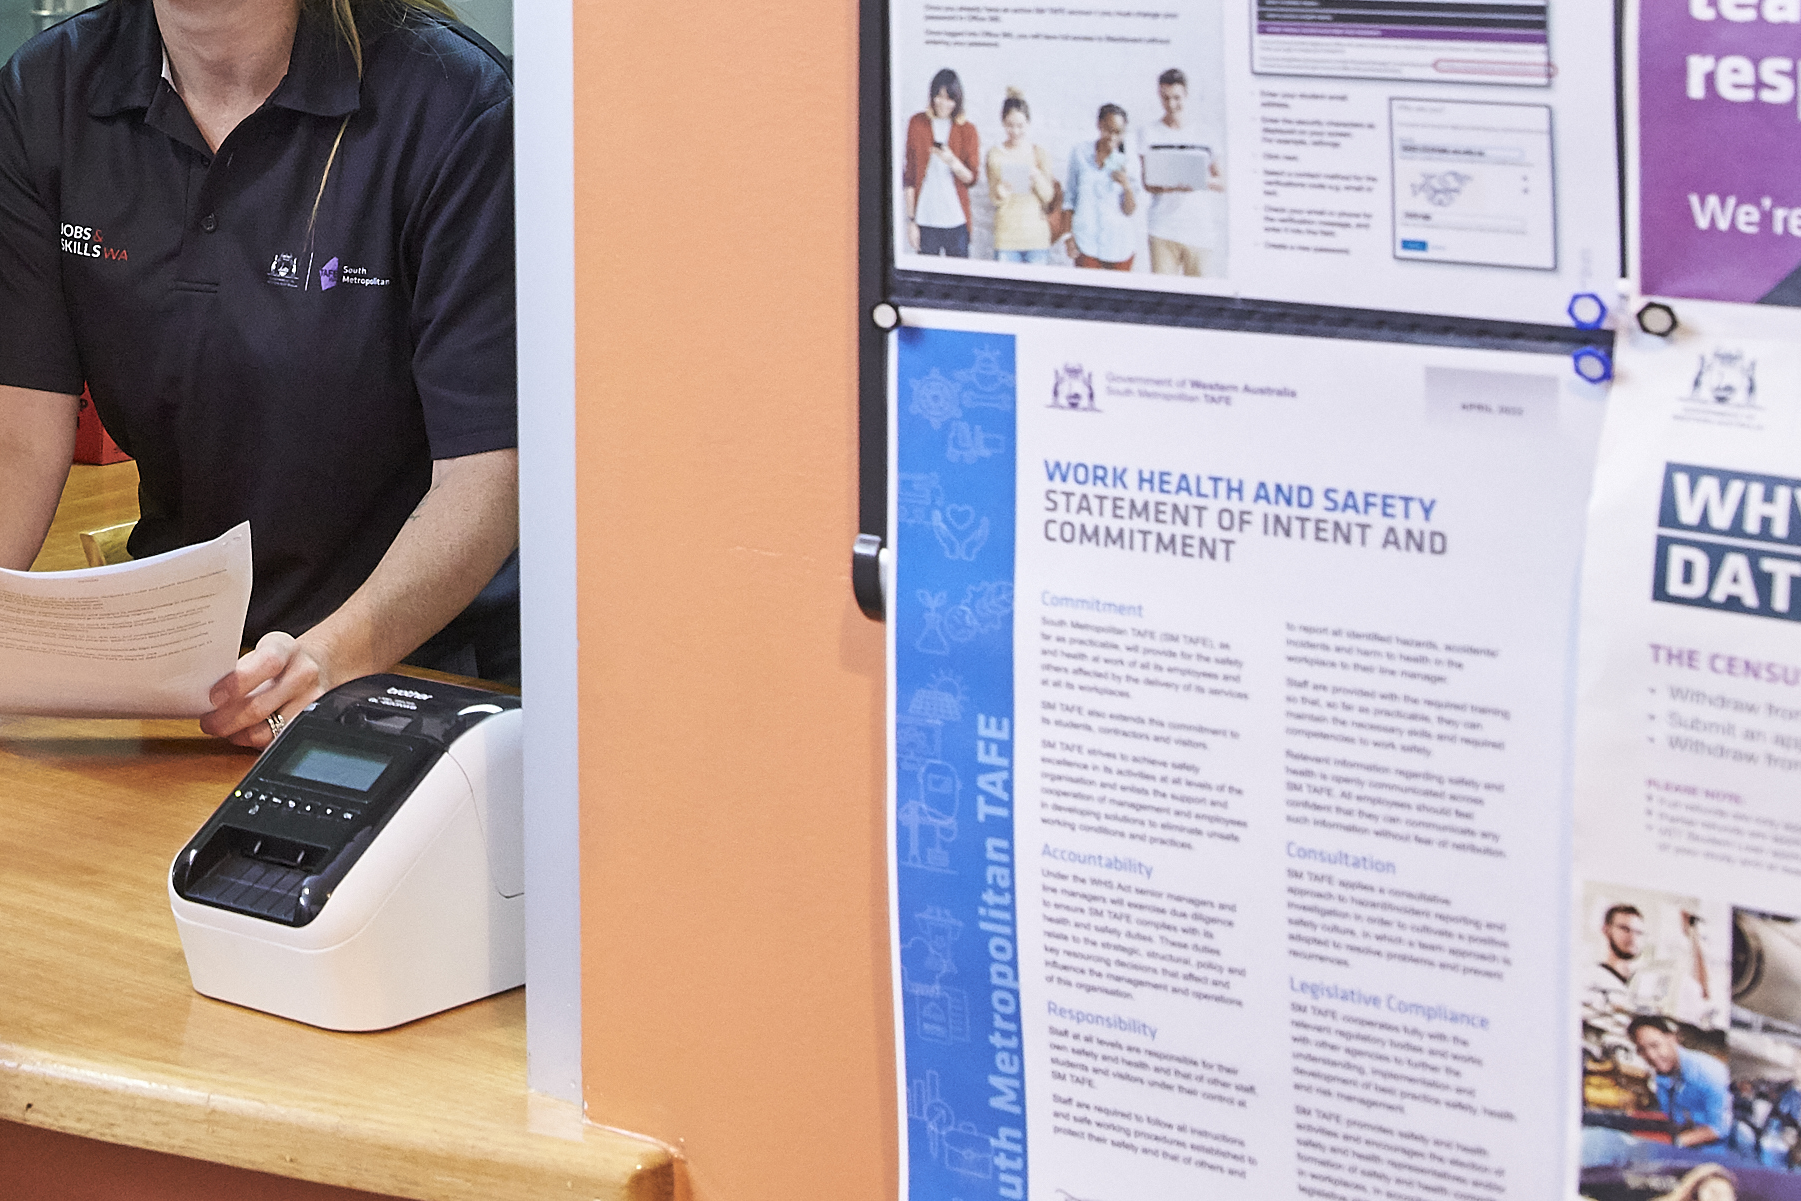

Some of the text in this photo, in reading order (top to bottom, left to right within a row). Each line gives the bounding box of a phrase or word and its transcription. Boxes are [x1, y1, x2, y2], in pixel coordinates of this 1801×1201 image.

[1686, 54, 1801, 121] res
[104, 247, 128, 261] WA
[343, 265, 367, 275] South
[342, 275, 390, 287] Metropolitan
[1045, 460, 1435, 521] WORK HEALTH AND SAFETY
[1672, 471, 1801, 542] WH
[1045, 489, 1447, 555] STATEMENT OF INTENT AND
[1045, 520, 1235, 561] COMMITMENT
[1041, 590, 1144, 617] Commitment
[1650, 644, 1700, 670] THE
[976, 713, 1011, 823] TAFE
[1042, 844, 1153, 879] Accountability
[1286, 841, 1396, 875] Consultation
[978, 837, 1023, 1113] Metropolitan
[1047, 1001, 1158, 1040] Responsibility
[1290, 977, 1489, 1030] Legislative Compliance
